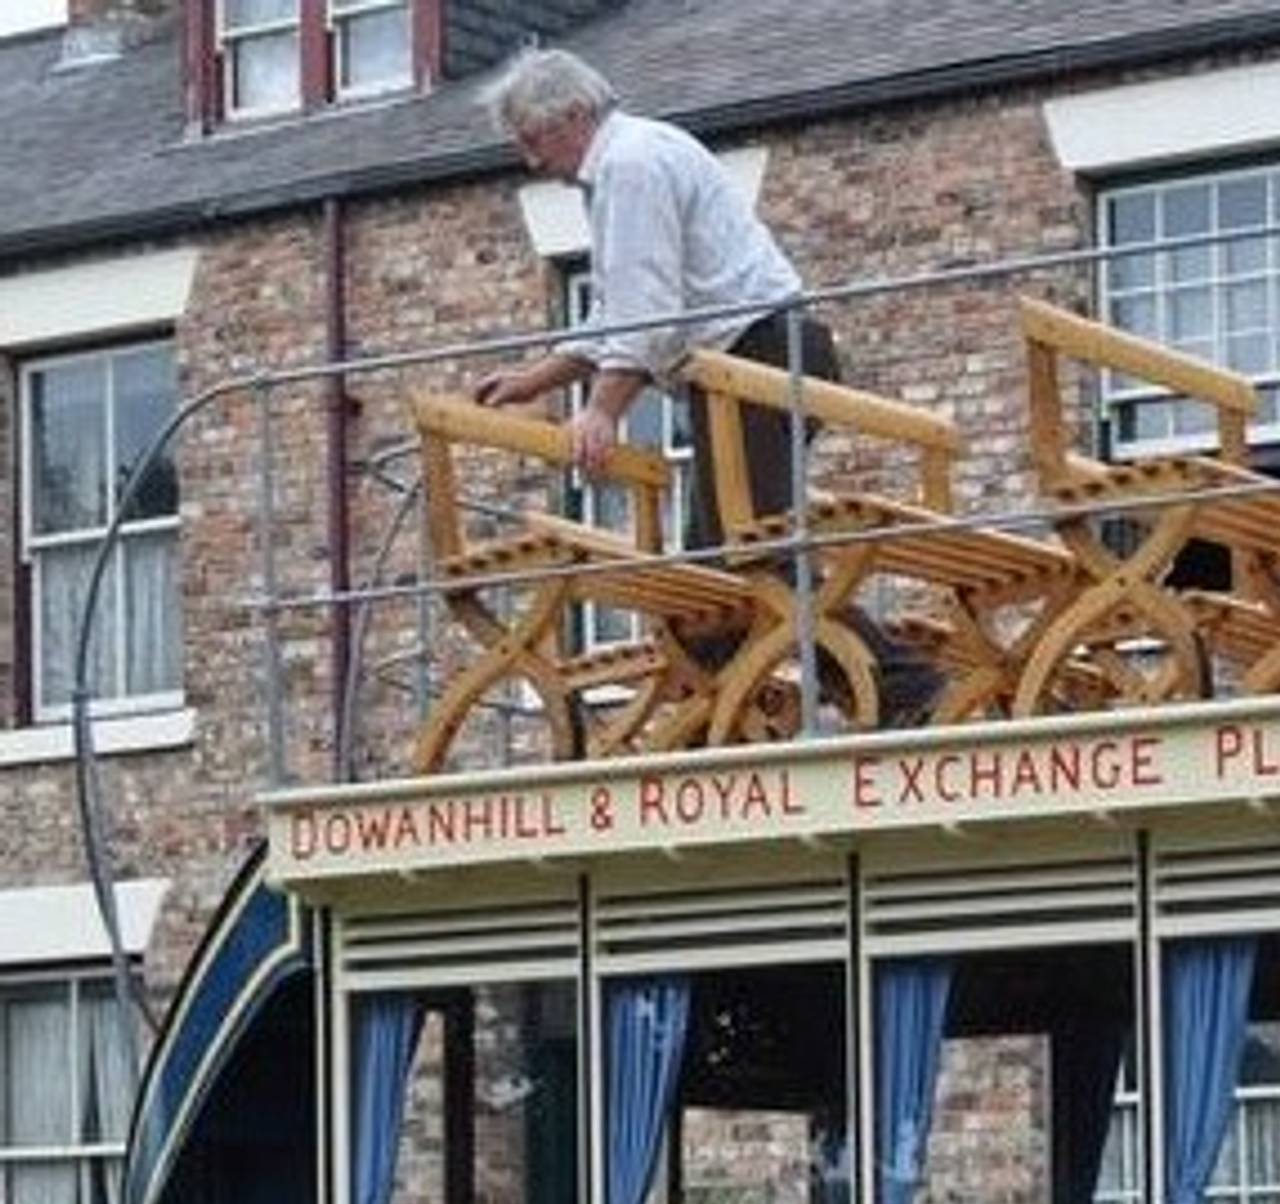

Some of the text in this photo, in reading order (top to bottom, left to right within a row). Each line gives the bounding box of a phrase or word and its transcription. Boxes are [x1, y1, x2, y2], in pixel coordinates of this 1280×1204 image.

[290, 794, 566, 860] DOWANHILL
[589, 786, 613, 830] &
[639, 772, 807, 827] ROYAL
[853, 737, 1164, 807] EXCHANGE
